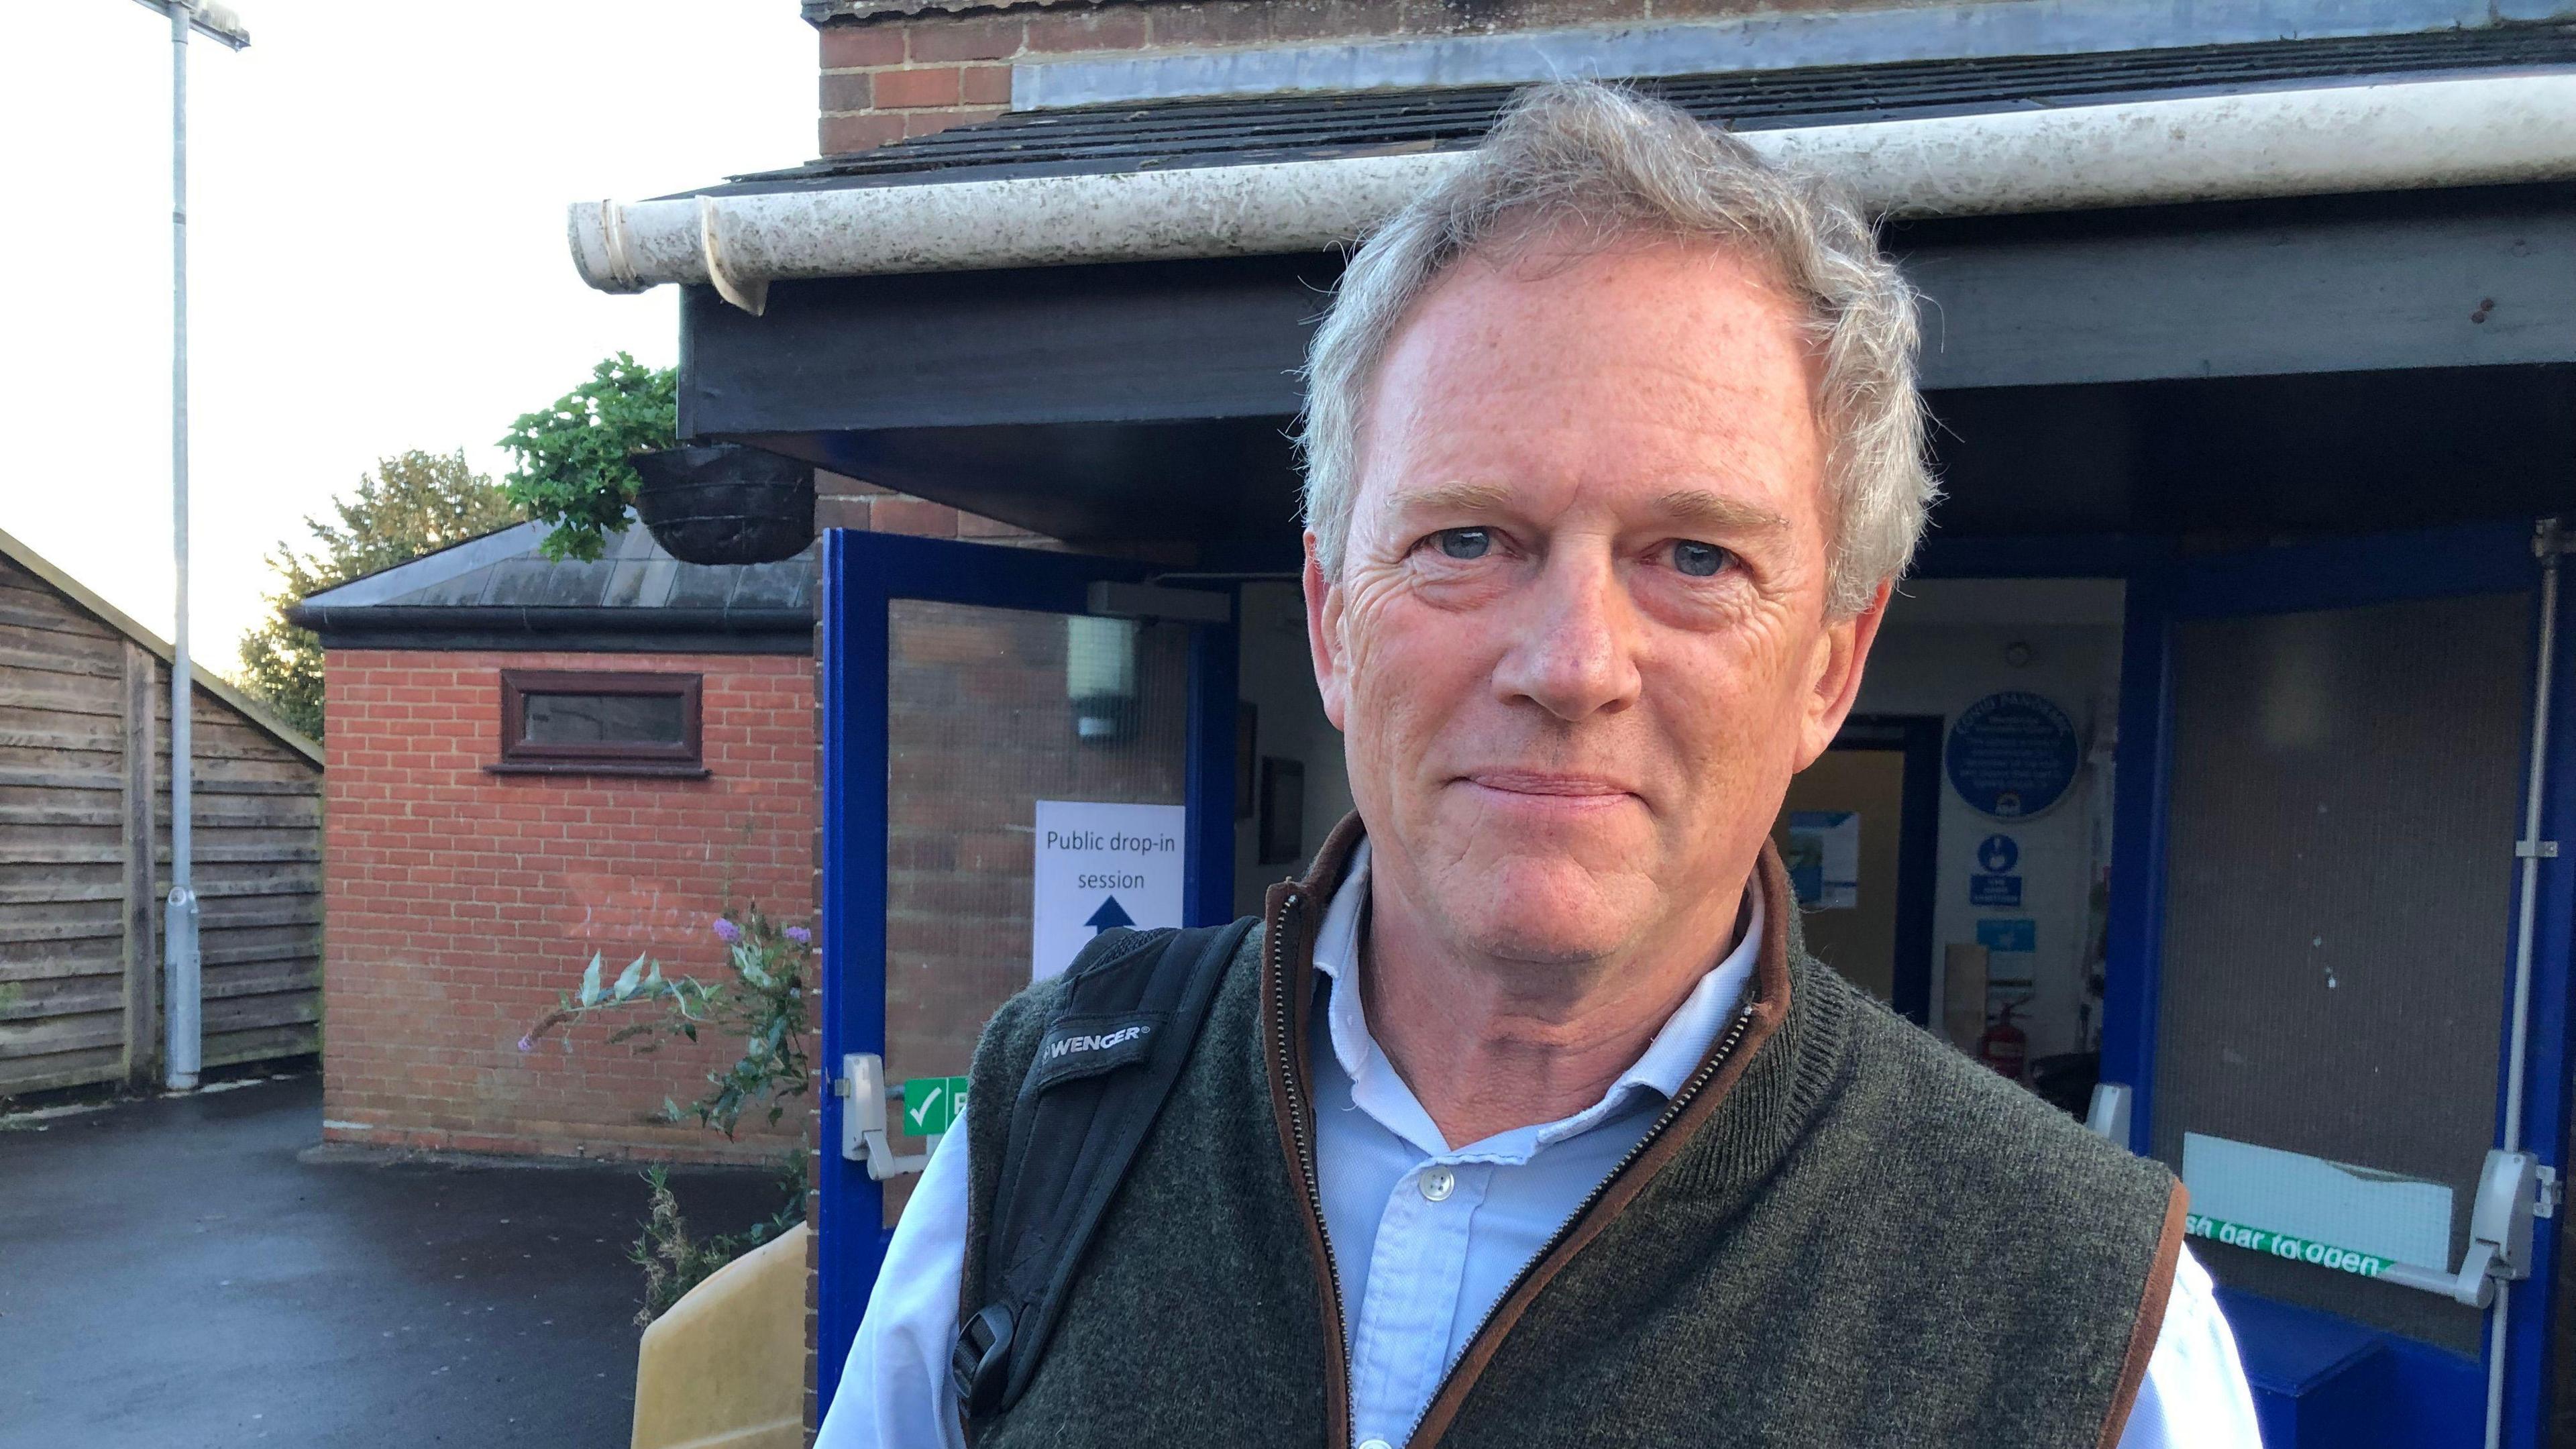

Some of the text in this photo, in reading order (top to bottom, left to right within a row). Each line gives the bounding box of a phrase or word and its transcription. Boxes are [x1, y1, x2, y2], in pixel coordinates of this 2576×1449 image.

[1047, 830, 1175, 856] Public drop-in
[1077, 870, 1144, 889] session
[2185, 1215, 2380, 1278] sh bar to open
